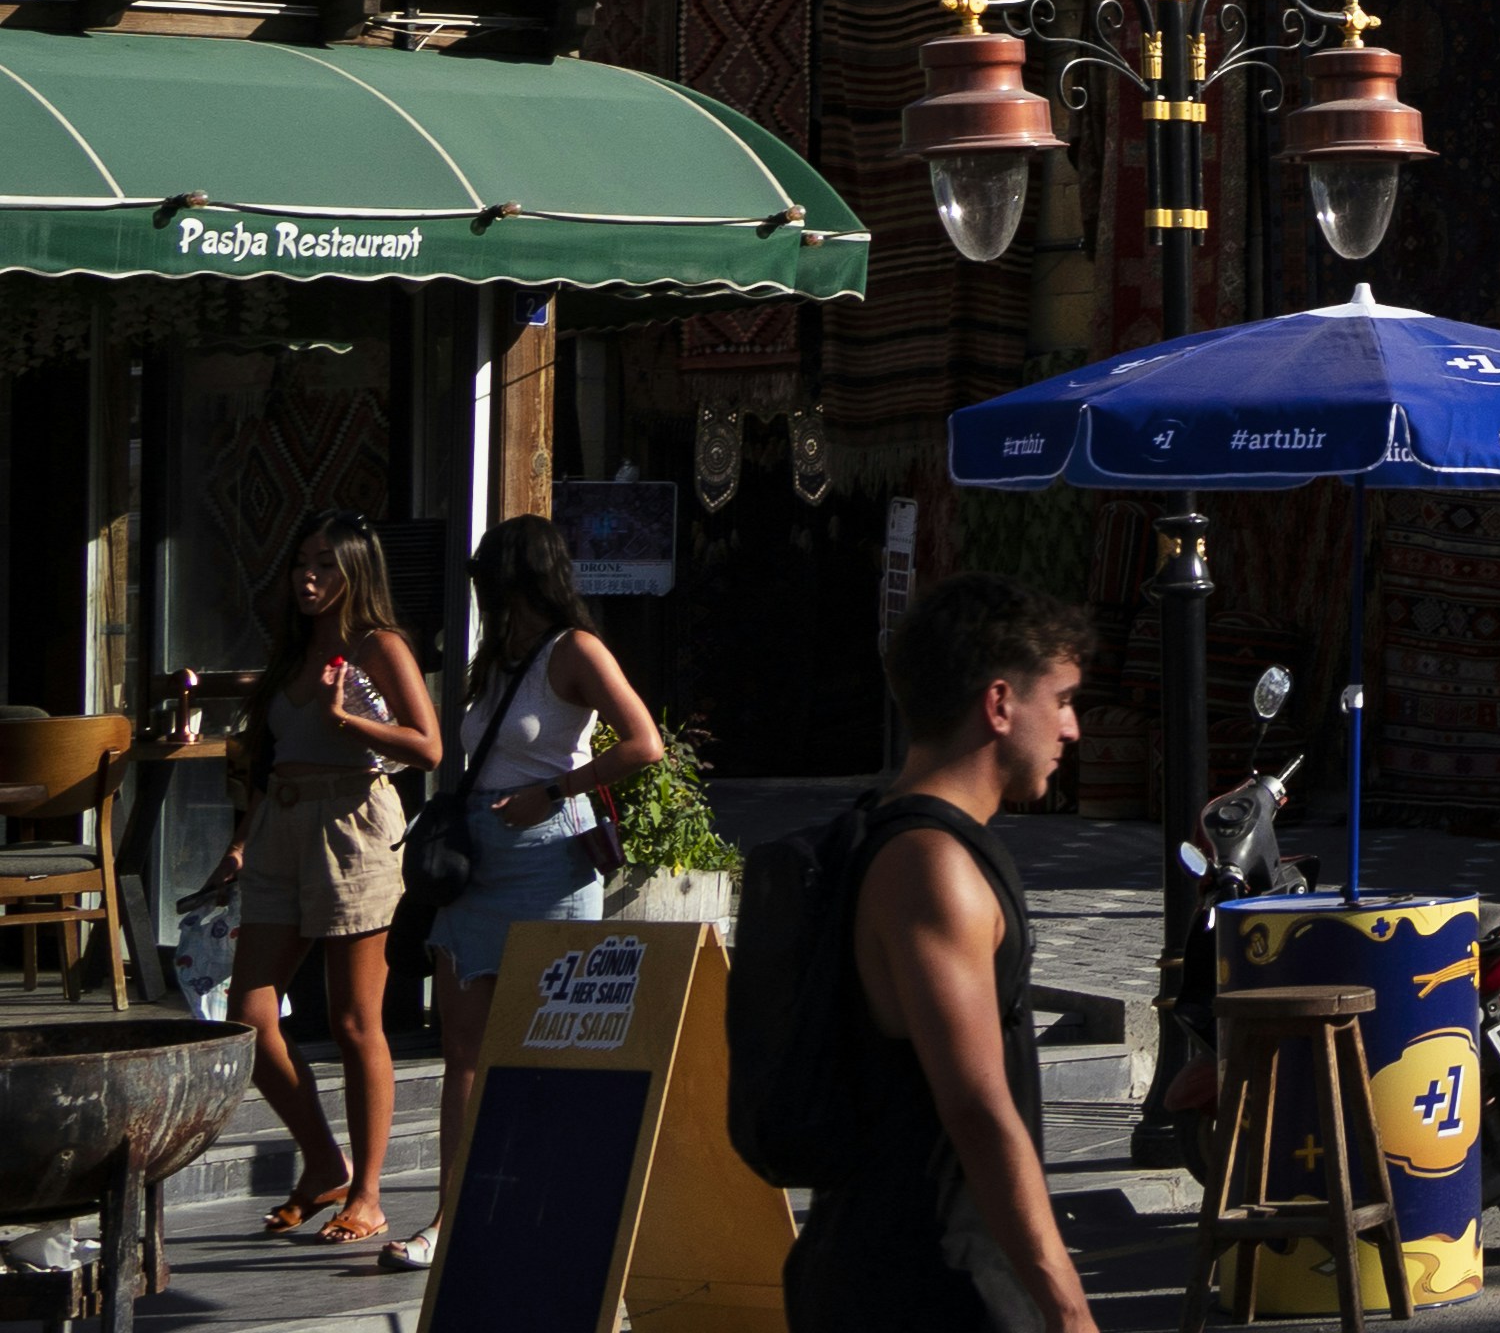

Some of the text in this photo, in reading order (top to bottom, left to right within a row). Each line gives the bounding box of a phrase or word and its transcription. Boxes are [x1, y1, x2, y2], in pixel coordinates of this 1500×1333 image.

[180, 217, 422, 262] Pasha Restaurant
[525, 297, 537, 318] 2
[1152, 430, 1174, 450] +1
[1230, 429, 1327, 450] #artıbir
[579, 563, 622, 573] DRONE
[587, 940, 643, 977] GÜNÜN
[544, 955, 580, 1001] +1
[569, 976, 637, 1005] HER SAATİ
[528, 1006, 631, 1042] MALT SAATİ
[1413, 1064, 1465, 1138] +1
